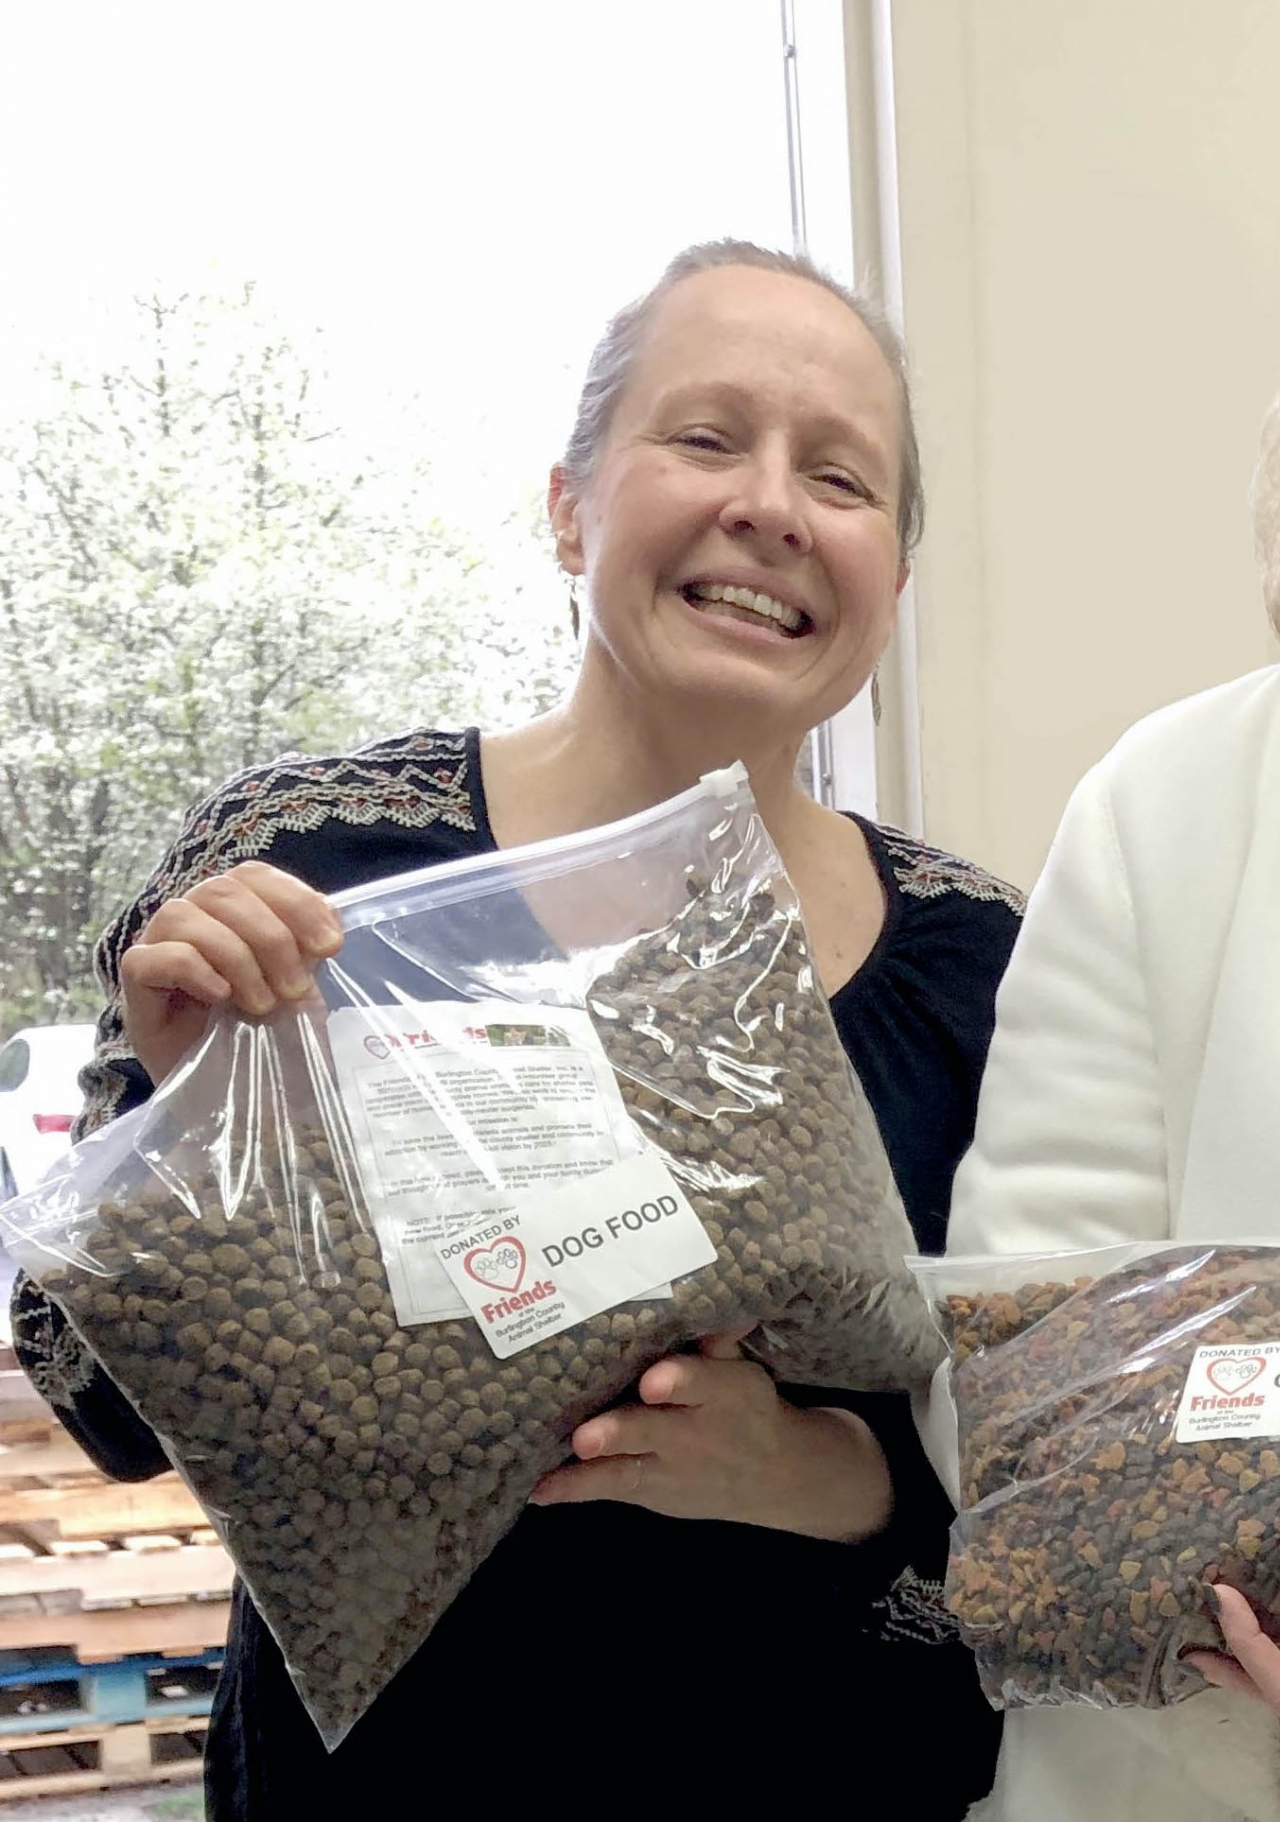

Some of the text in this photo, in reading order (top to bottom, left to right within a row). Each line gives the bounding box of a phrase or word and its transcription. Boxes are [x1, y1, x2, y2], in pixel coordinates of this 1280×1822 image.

[440, 1214, 522, 1260] DONATED BY
[541, 1195, 679, 1268] DOG FOOD
[480, 1279, 557, 1325] Friends
[494, 1300, 566, 1338] Burlington County
[507, 1312, 563, 1342] Animal Shelter
[1198, 1346, 1261, 1359] DONATED
[1190, 1392, 1266, 1412] Friends
[1188, 1412, 1262, 1425] Burlington County
[1195, 1420, 1253, 1432] Animal Shelter
